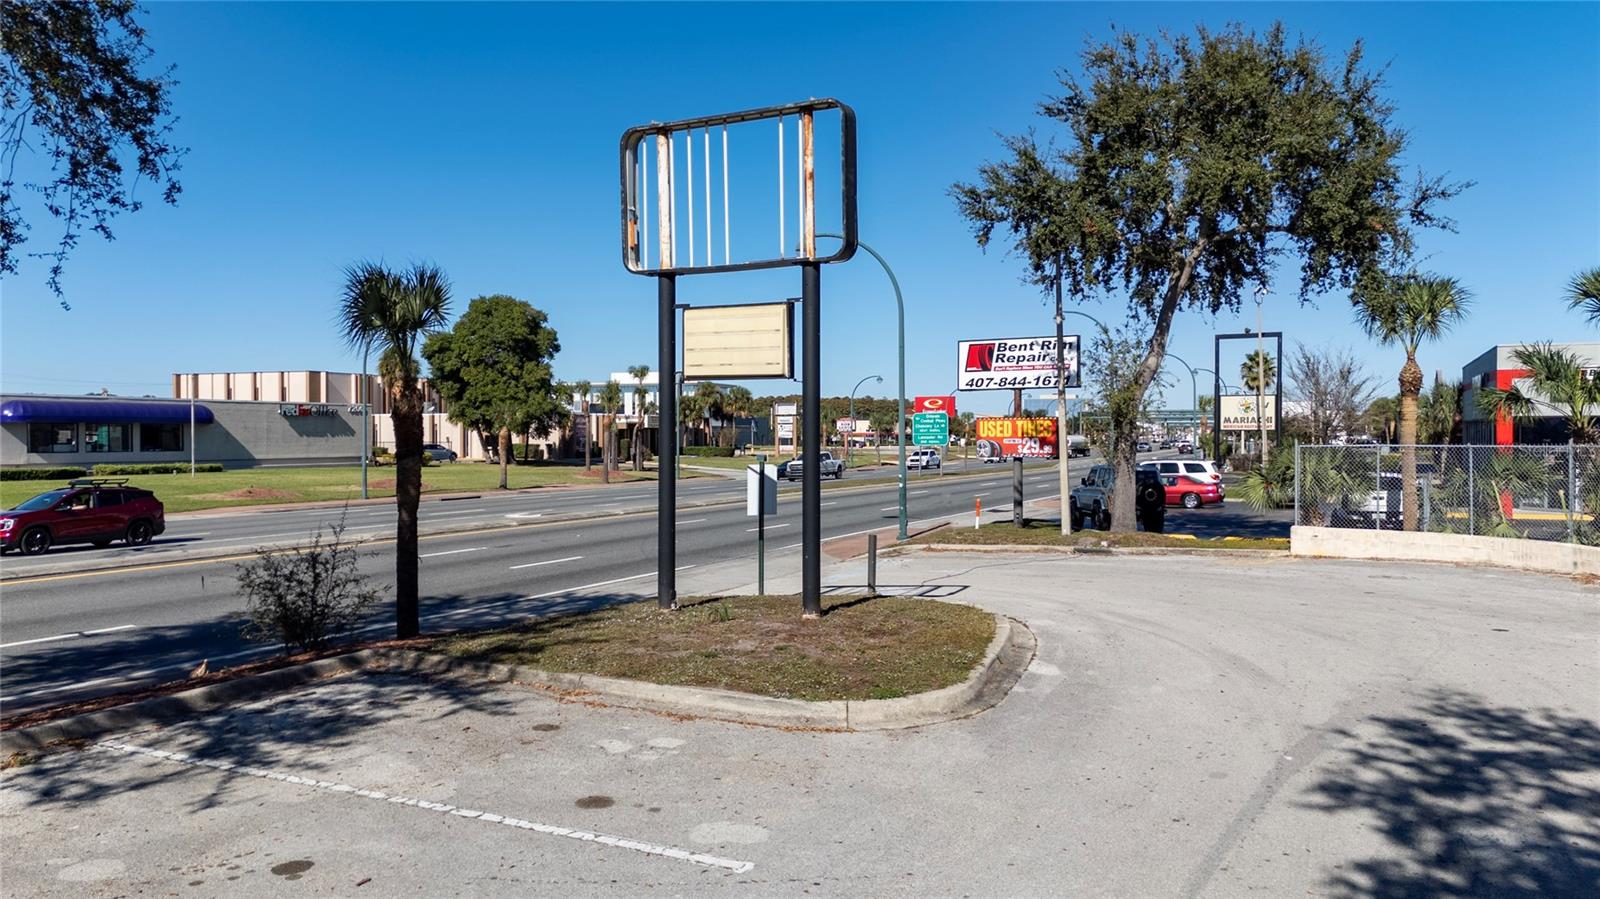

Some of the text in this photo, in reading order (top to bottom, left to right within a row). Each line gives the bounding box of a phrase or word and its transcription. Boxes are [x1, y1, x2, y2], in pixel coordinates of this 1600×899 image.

[997, 341, 1034, 352] Bent
[995, 352, 1049, 364] Repair
[980, 420, 1052, 437] USED TIRES
